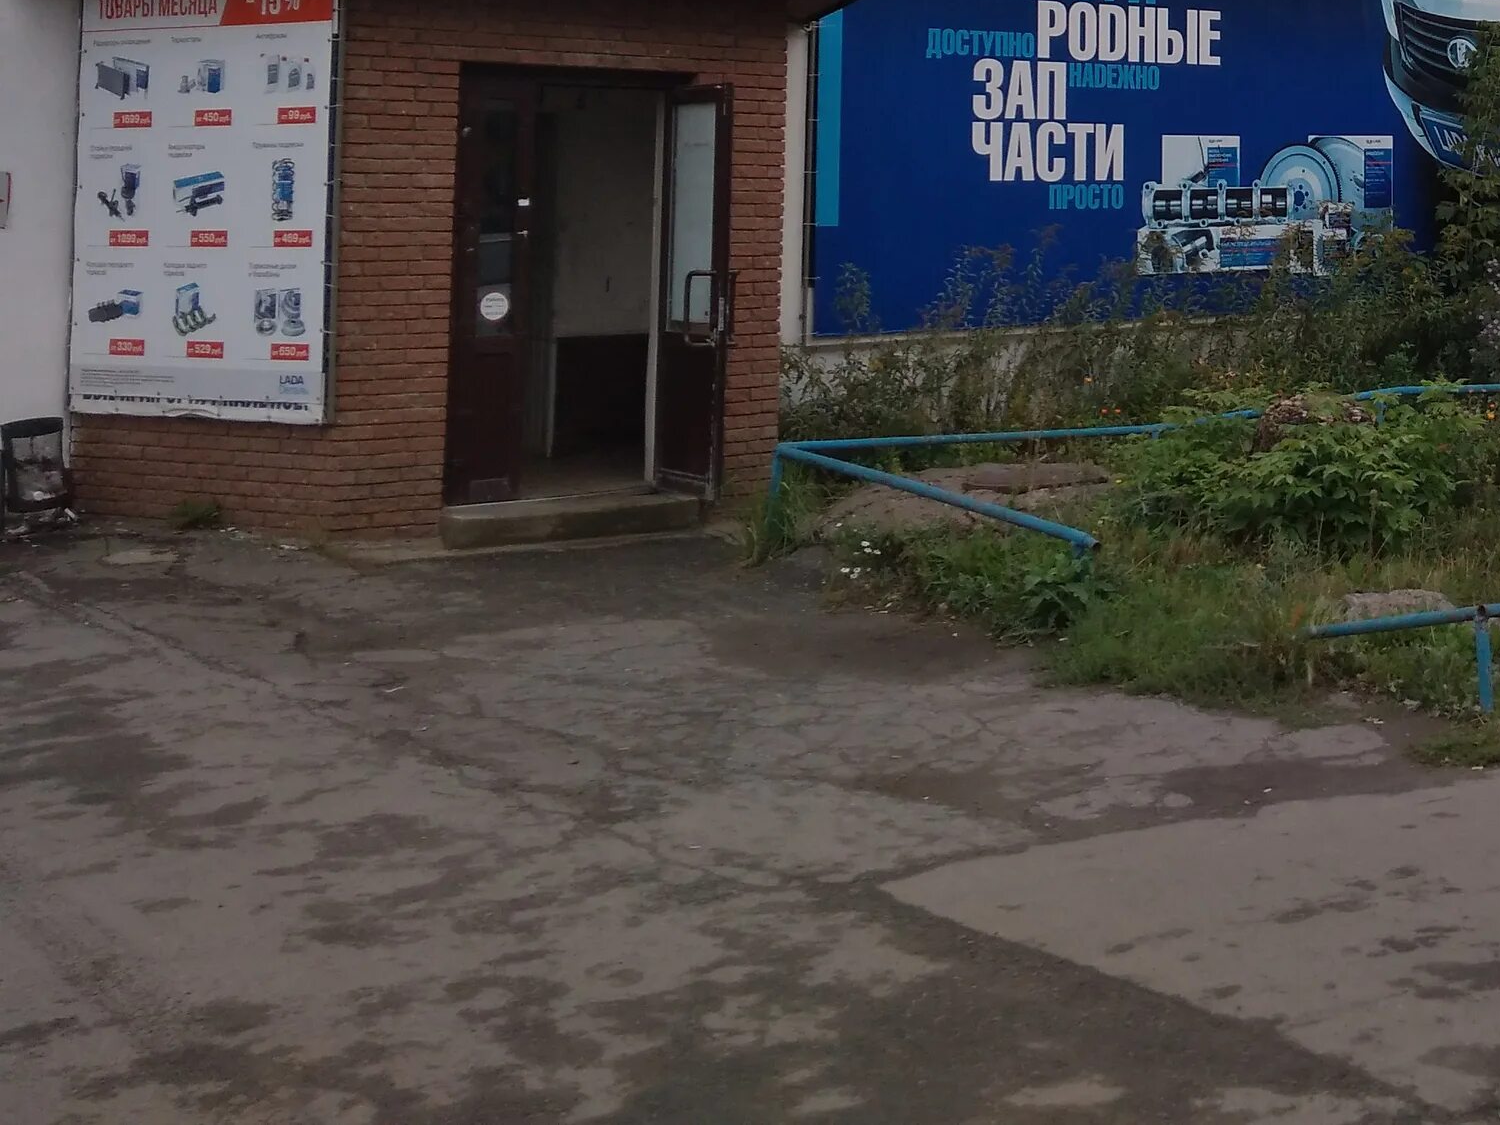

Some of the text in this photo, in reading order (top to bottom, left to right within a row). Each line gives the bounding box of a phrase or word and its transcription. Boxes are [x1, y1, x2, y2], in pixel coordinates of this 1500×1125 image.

[926, 27, 1035, 59] ДОСТУПНО
[972, 58, 1067, 120] ЗАП
[971, 121, 1125, 182] ЧАСТИ
[1049, 183, 1125, 211] ПРОСТО
[279, 375, 304, 385] LADA
